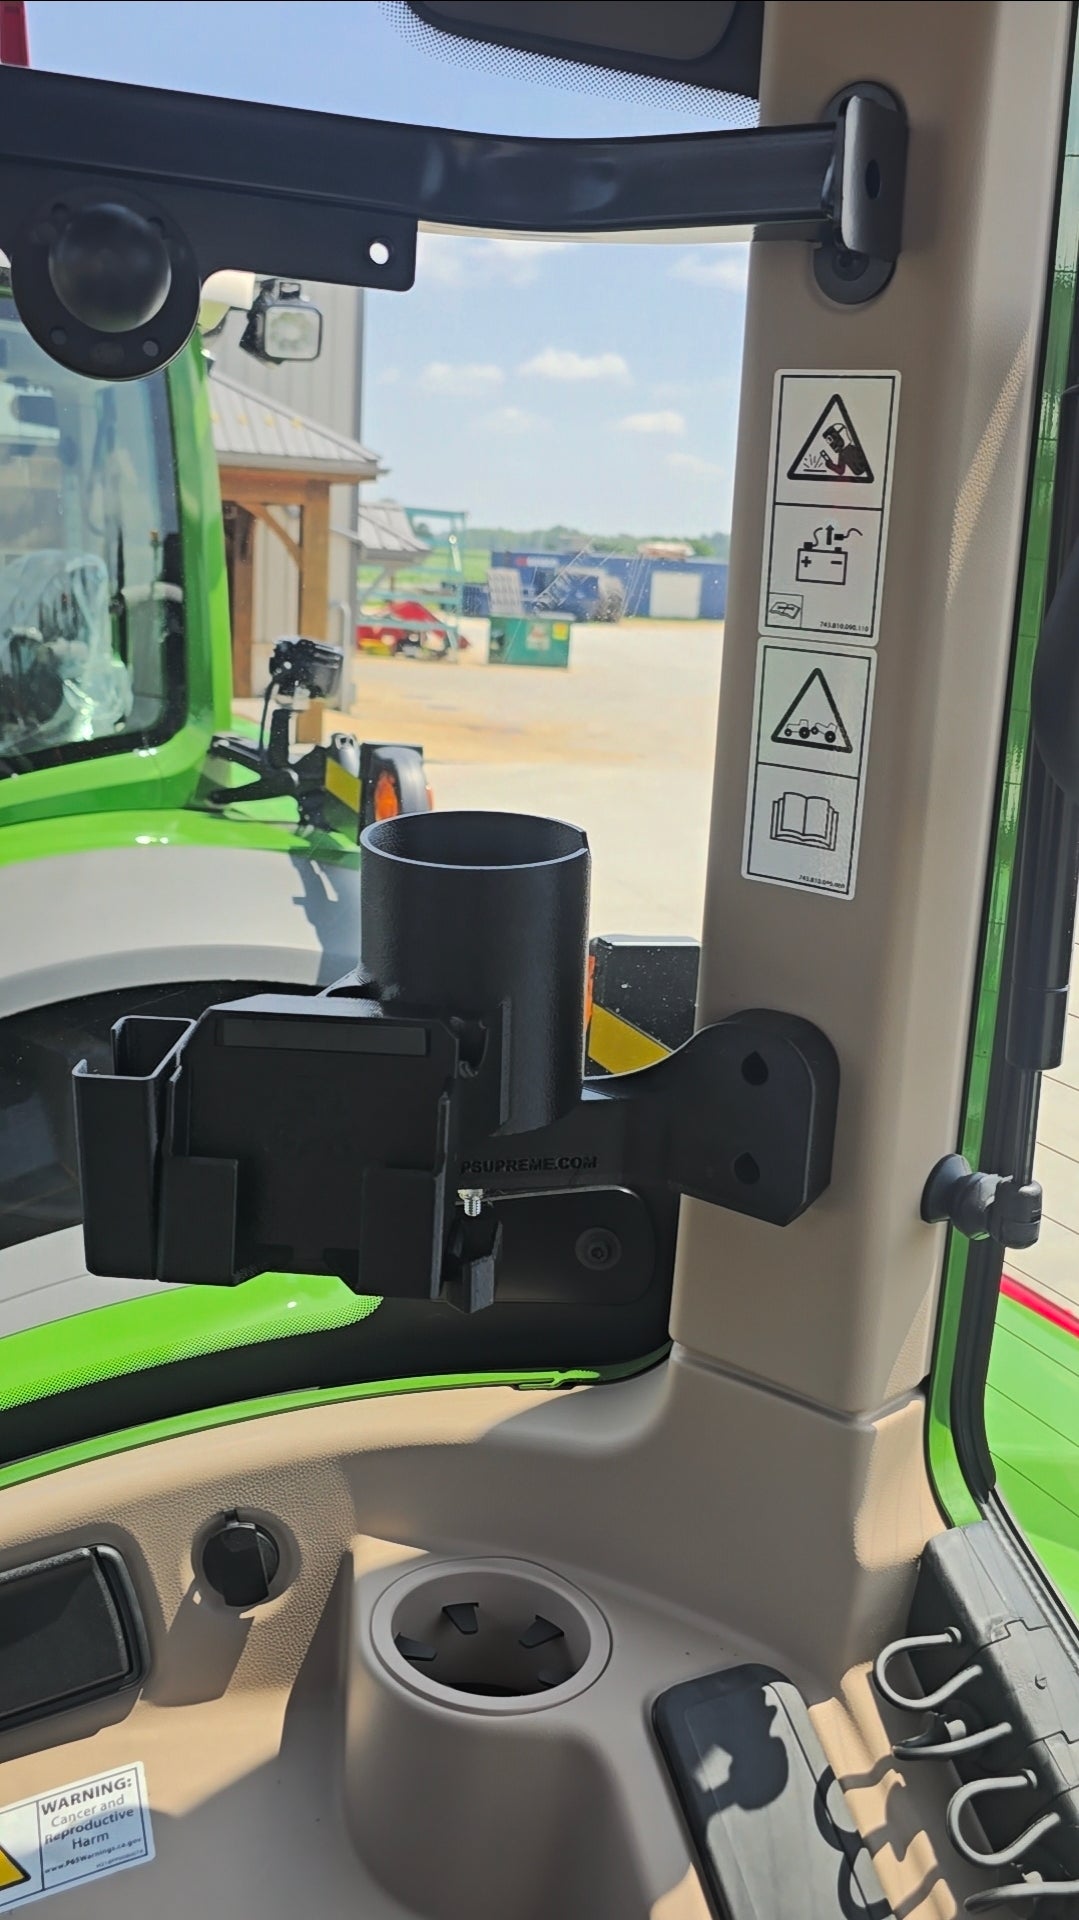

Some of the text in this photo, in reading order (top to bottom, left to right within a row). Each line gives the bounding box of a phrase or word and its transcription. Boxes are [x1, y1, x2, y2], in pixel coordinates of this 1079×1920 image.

[41, 1777, 133, 1816] WARNING:
[51, 1794, 125, 1828] Cancer and
[44, 1808, 134, 1845] Reproductive
[72, 1832, 110, 1850] Harm
